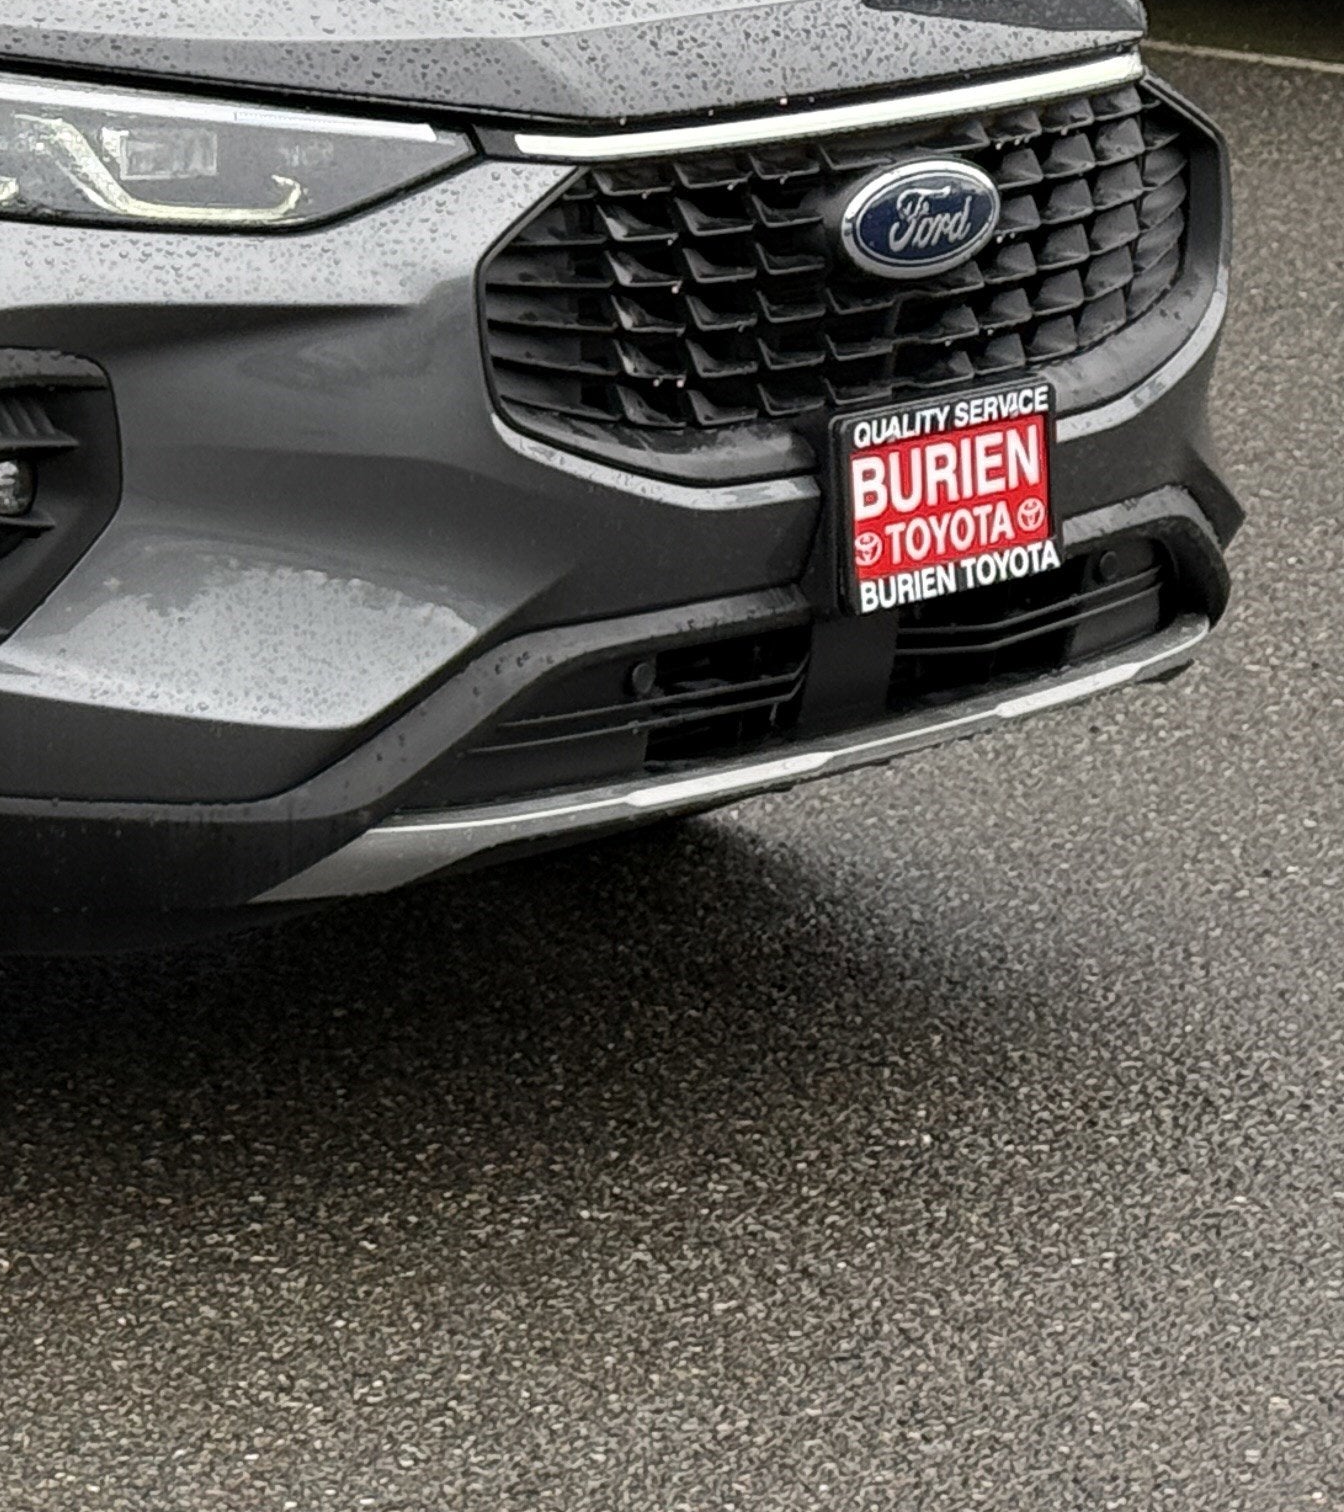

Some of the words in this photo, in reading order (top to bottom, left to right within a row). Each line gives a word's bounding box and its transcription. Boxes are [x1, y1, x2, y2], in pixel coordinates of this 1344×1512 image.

[888, 185, 972, 253] Ford
[853, 405, 951, 448] QUALITY
[954, 385, 1049, 428] SERVICE
[851, 424, 1041, 521] BURIEN
[885, 500, 1015, 565] TOYOTA
[860, 560, 957, 613] BURIEN
[962, 539, 1061, 588] TOYOTA
